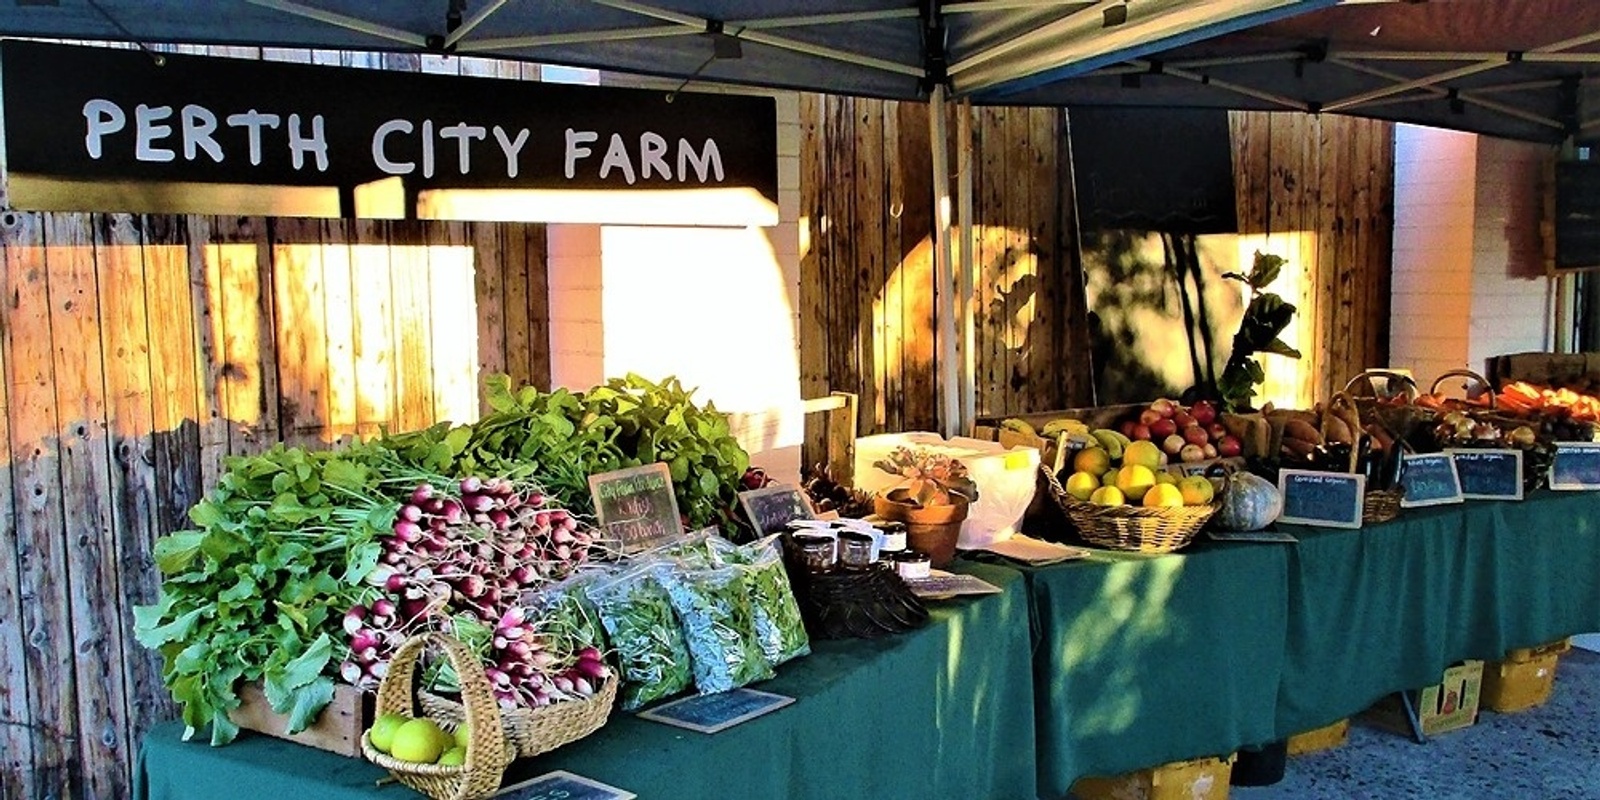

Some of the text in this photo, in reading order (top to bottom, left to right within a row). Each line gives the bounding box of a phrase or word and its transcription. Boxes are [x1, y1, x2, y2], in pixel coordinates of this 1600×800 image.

[83, 99, 725, 184] PERTH CITY FARM
